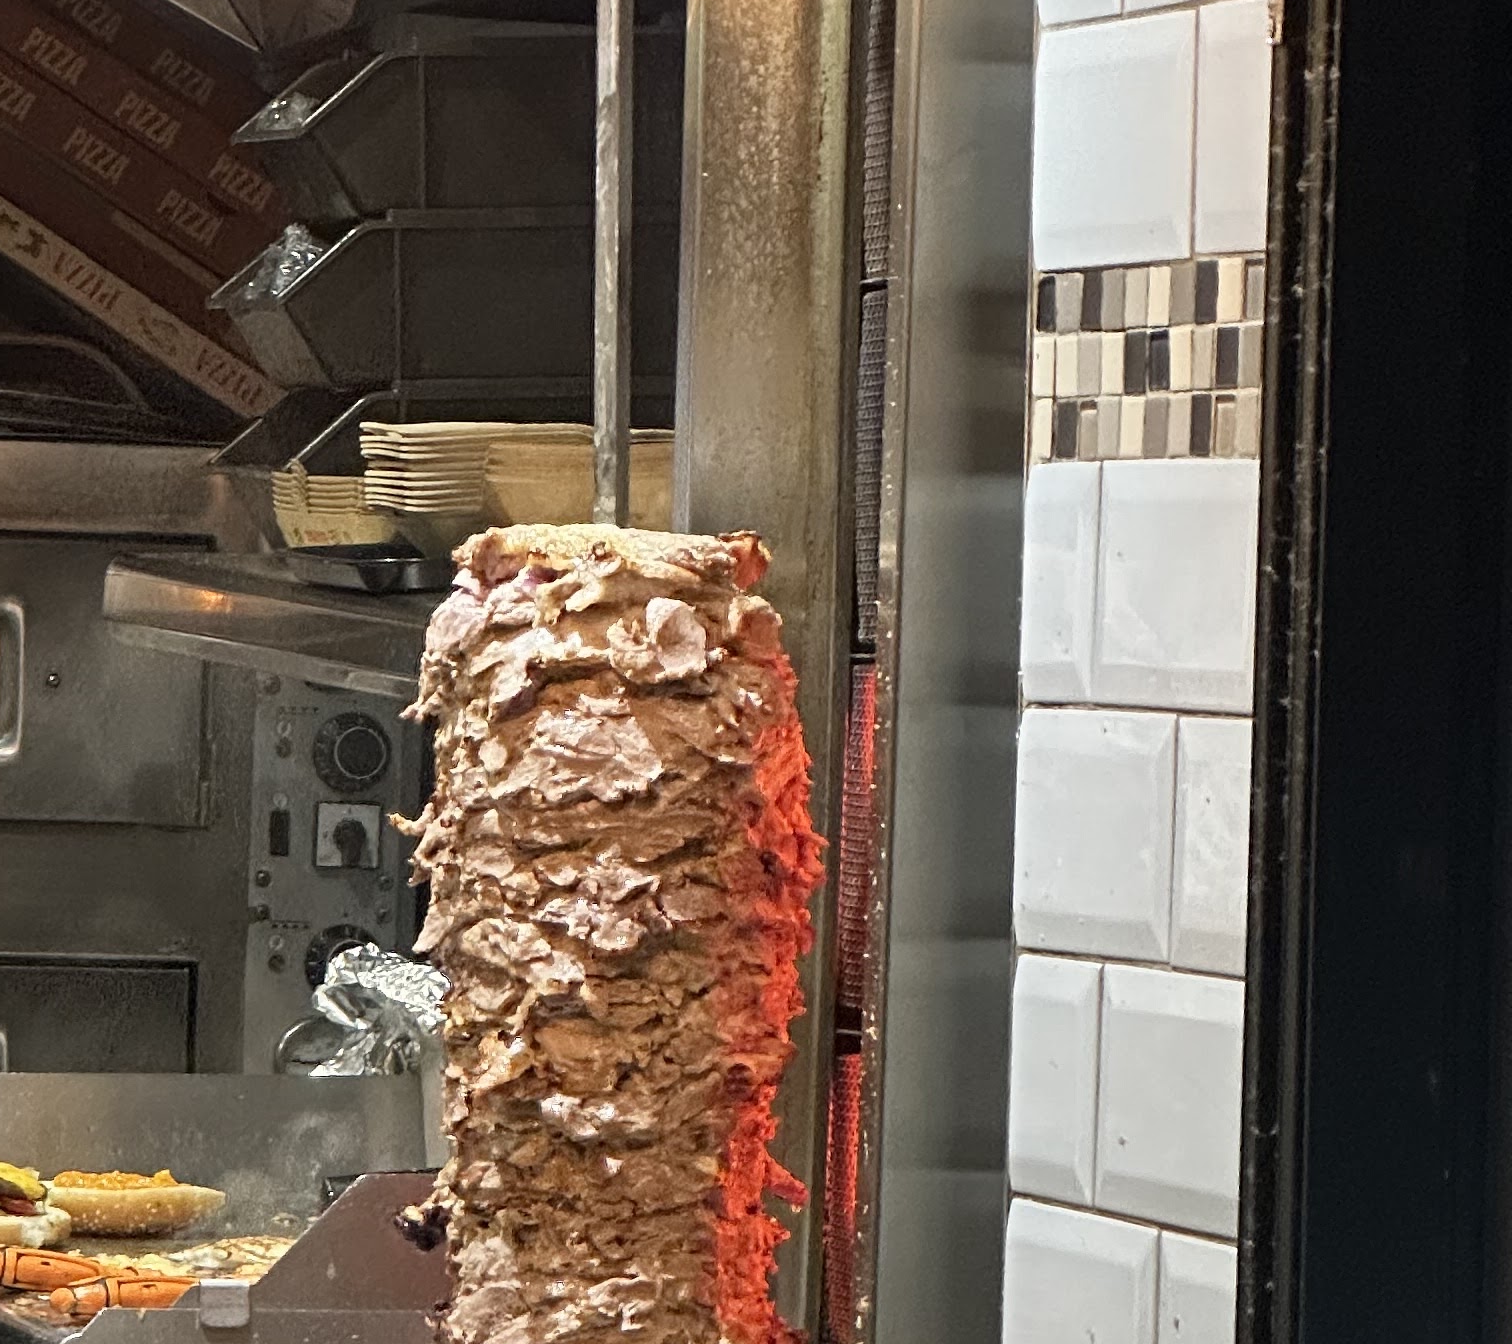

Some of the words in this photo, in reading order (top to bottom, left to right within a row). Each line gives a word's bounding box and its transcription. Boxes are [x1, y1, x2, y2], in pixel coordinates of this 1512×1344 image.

[19, 26, 89, 86] PIZZA
[114, 89, 182, 149] PIZZA
[208, 154, 276, 212] PIZZA
[150, 48, 216, 106] PIZZA
[63, 127, 131, 185] PIZZA
[156, 188, 224, 247] PIZZA
